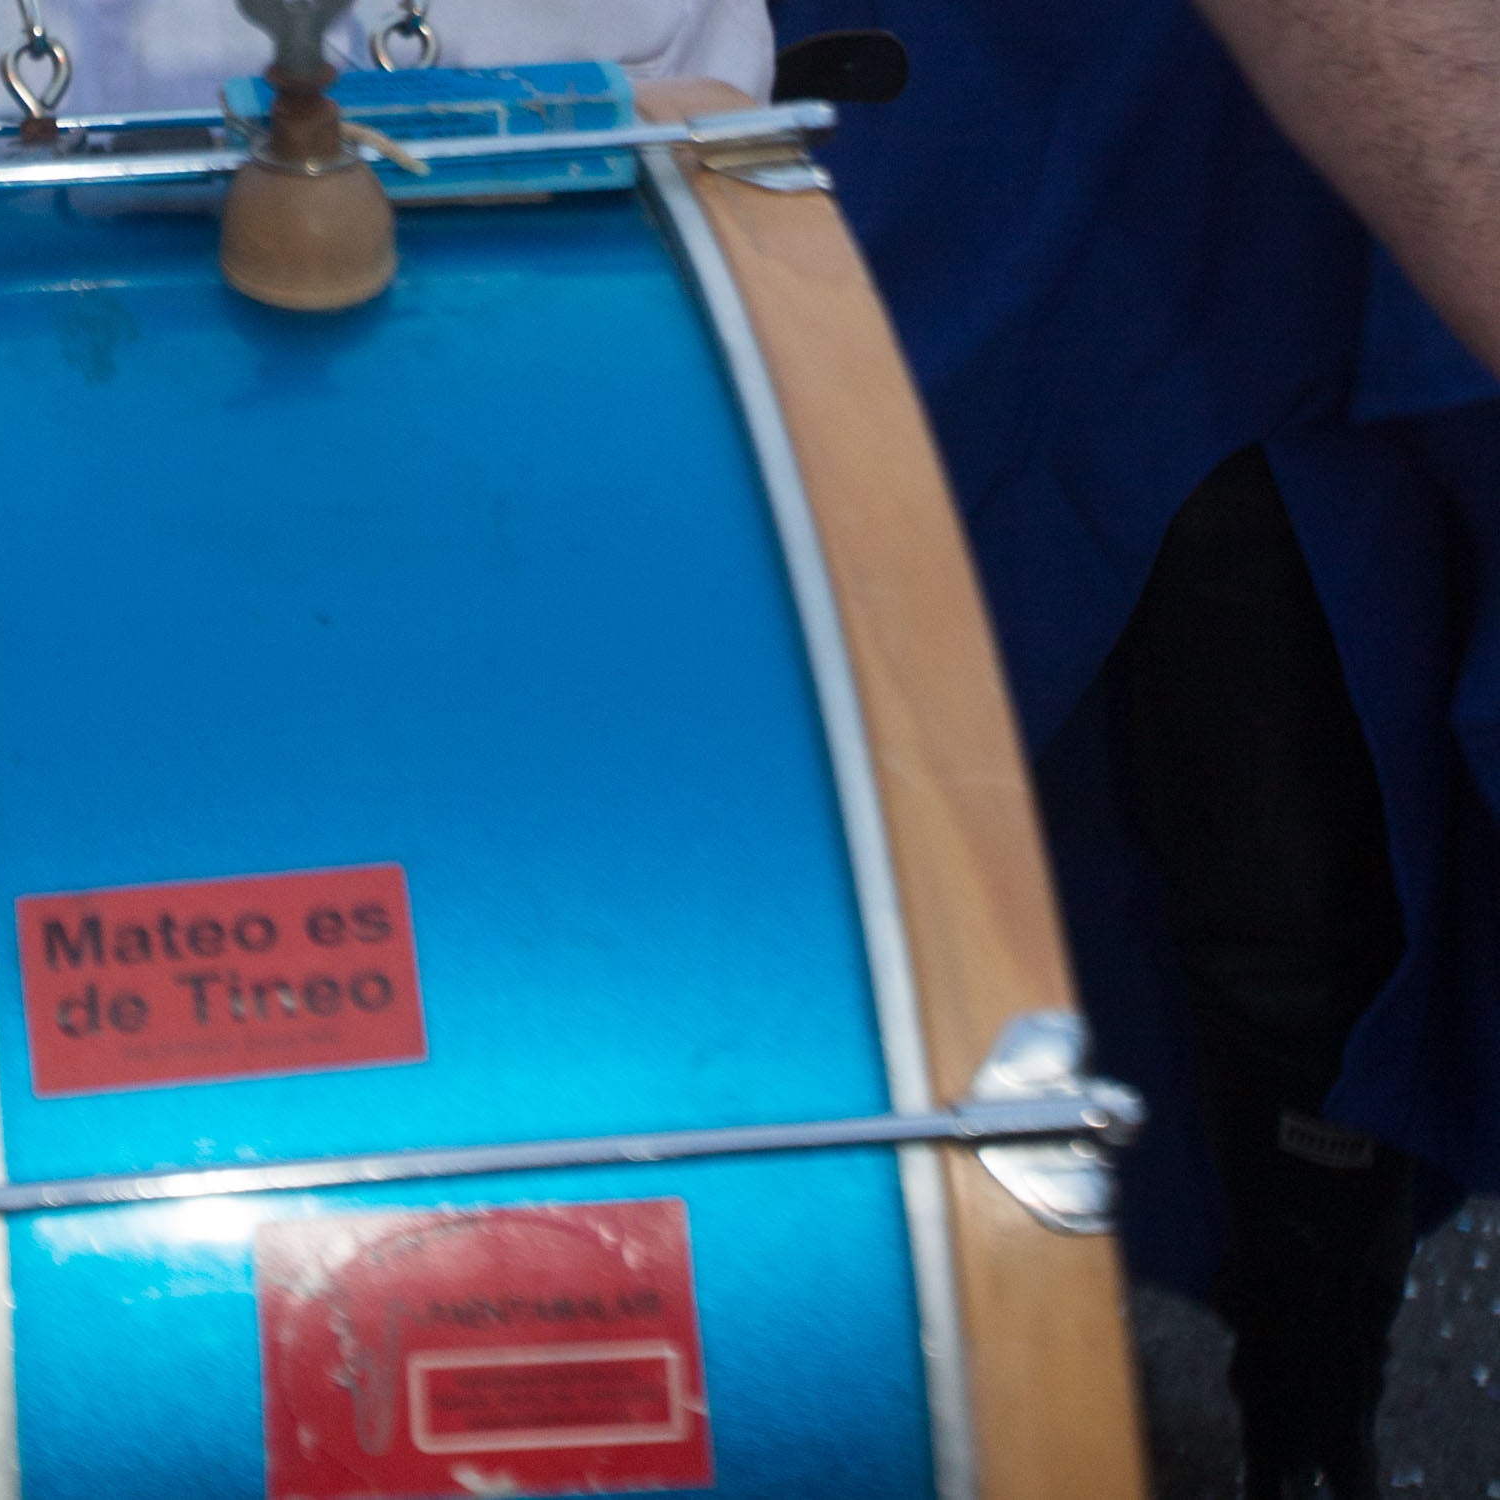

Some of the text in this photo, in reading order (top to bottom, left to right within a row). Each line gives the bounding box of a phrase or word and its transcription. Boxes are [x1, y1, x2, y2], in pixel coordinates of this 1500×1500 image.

[41, 902, 393, 970] Mateo es
[56, 968, 395, 1038] de Tineo
